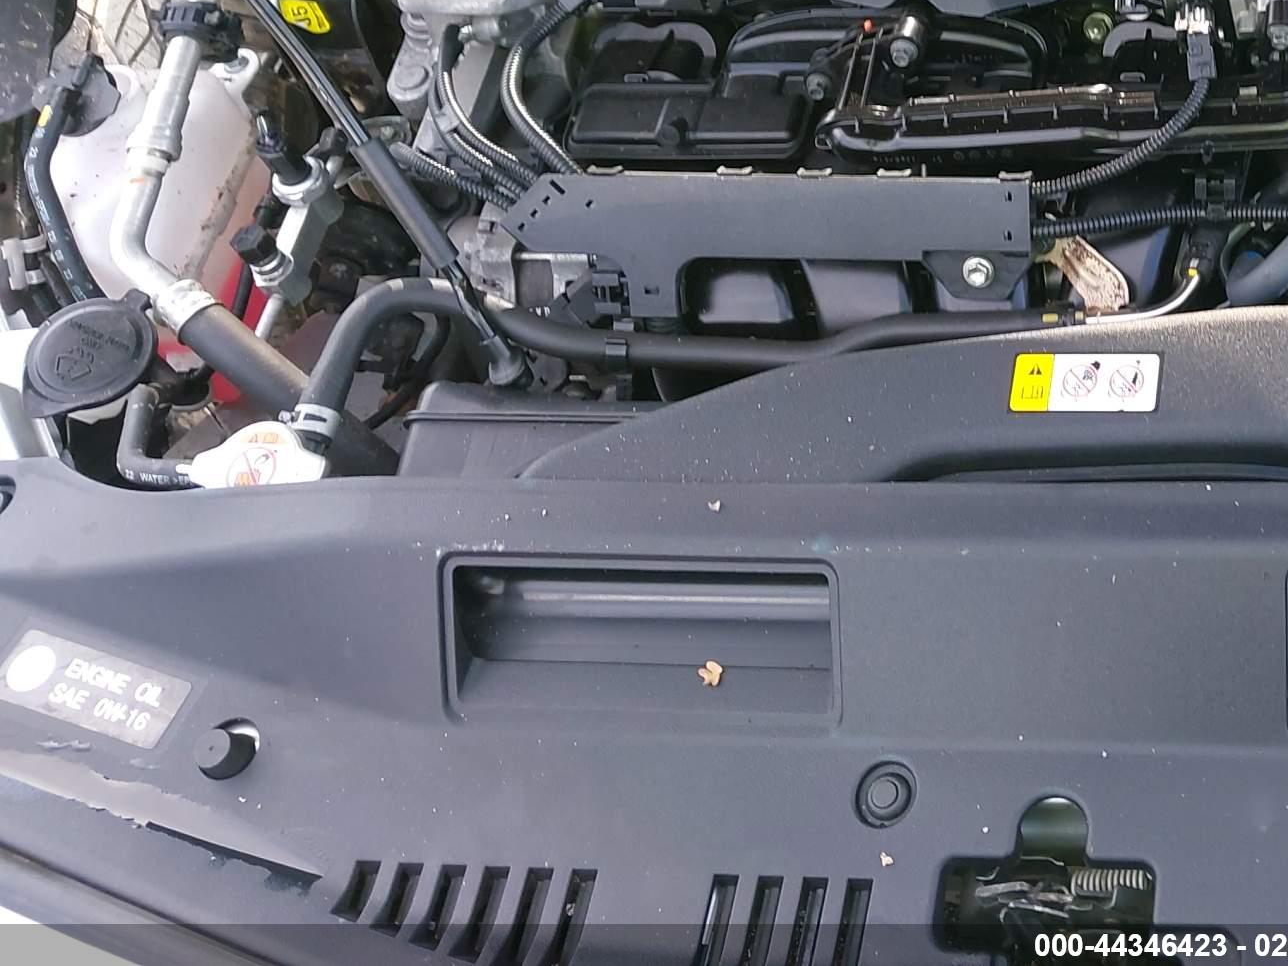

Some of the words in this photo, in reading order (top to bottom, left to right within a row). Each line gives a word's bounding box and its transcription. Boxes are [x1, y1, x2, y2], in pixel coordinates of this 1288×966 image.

[139, 472, 170, 486] WATER
[48, 682, 91, 711] SAE
[93, 697, 152, 731] 0W-16
[64, 658, 132, 695] ENGINE
[134, 682, 162, 708] OIL
